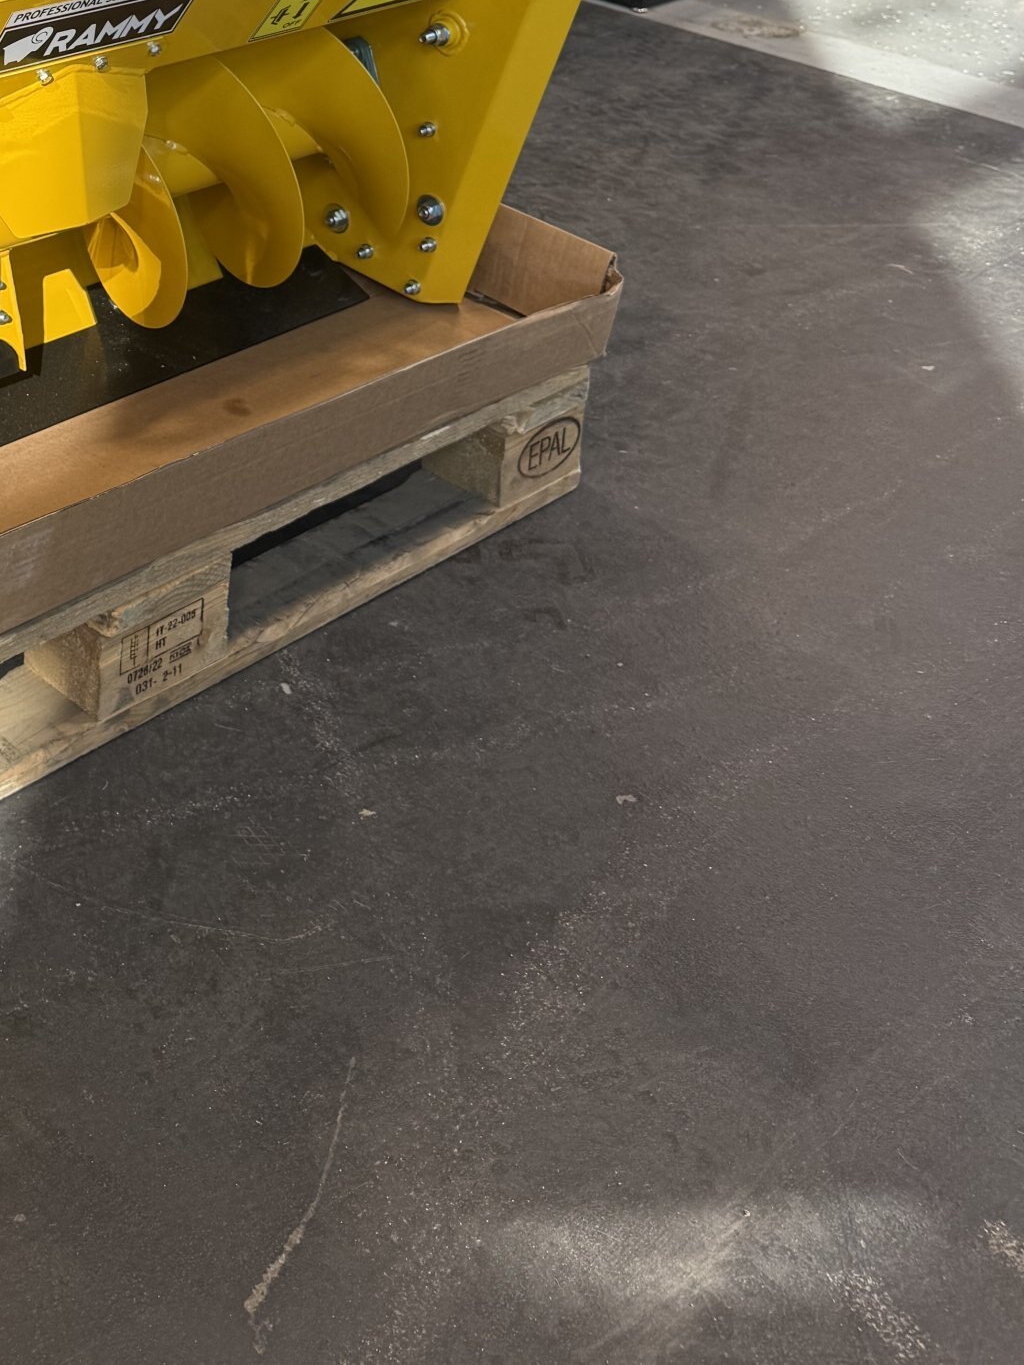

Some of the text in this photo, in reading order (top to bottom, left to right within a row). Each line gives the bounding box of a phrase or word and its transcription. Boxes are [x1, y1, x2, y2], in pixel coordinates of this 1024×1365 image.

[43, 3, 184, 57] RAMMY
[528, 427, 570, 471] EPAL
[155, 636, 167, 650] HT
